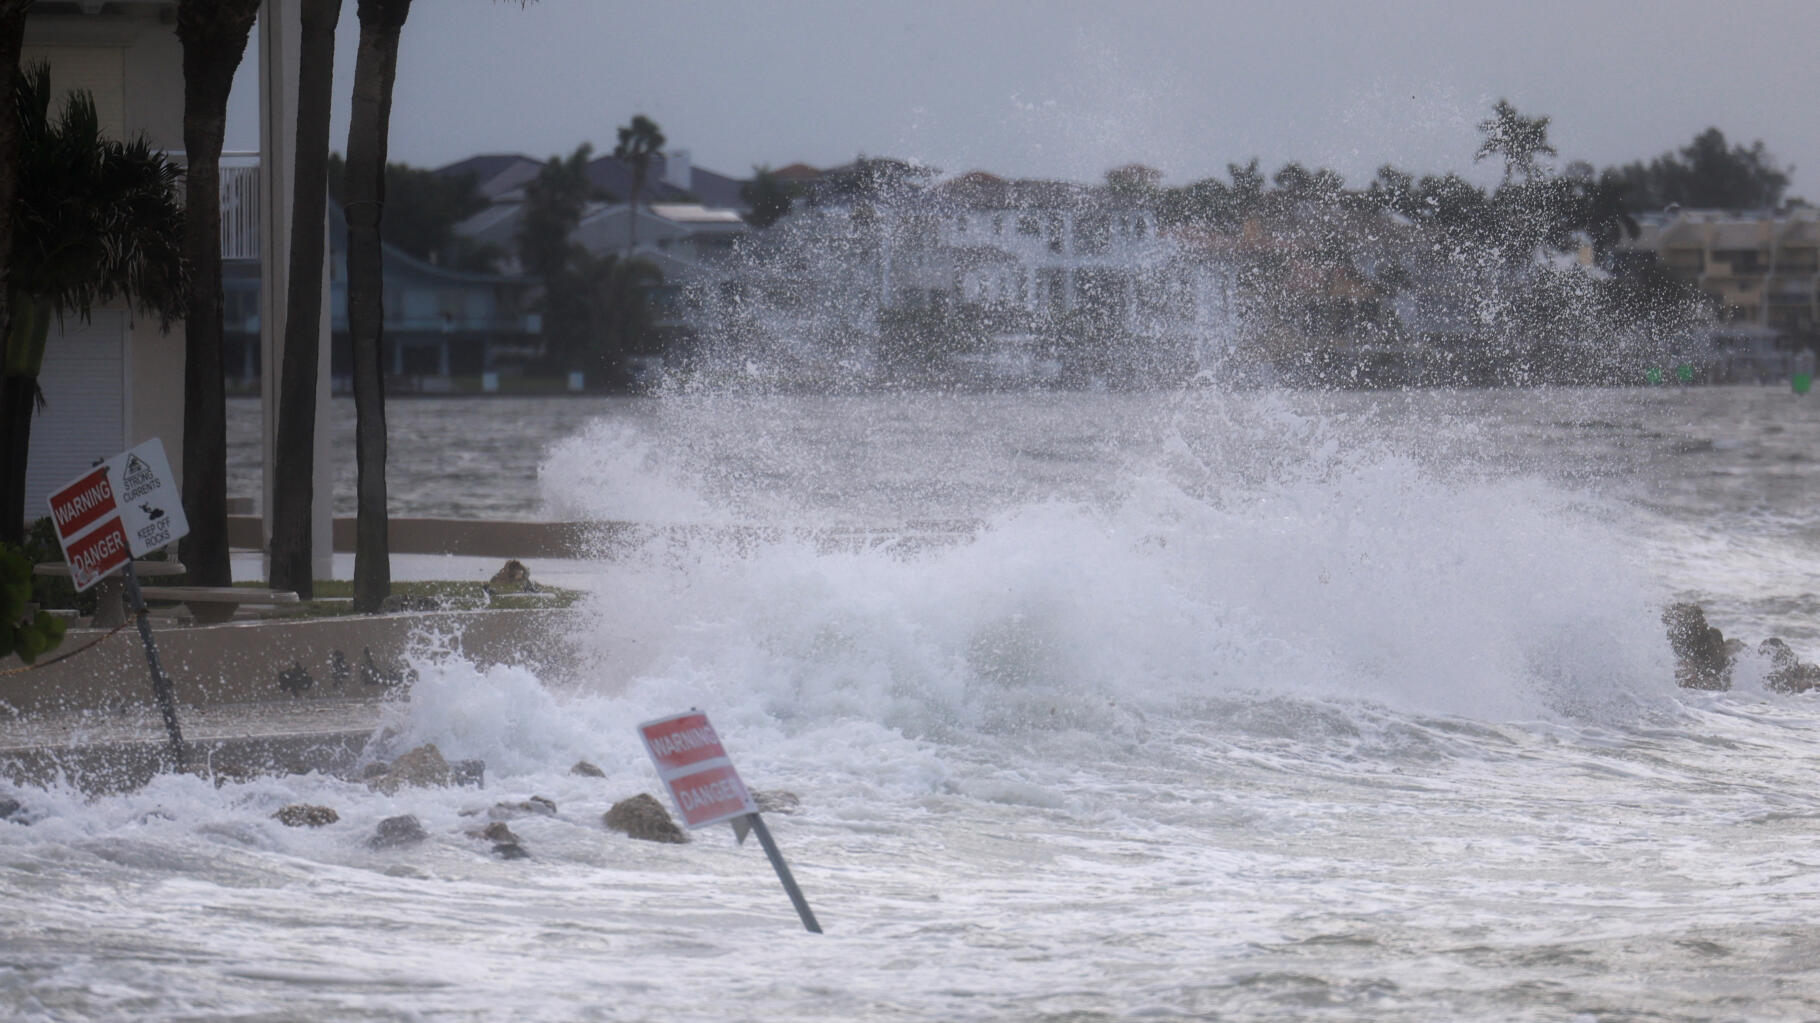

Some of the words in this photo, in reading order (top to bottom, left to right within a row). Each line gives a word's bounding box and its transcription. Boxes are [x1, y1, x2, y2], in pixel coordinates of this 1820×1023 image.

[55, 481, 112, 526] WARNING
[123, 478, 161, 503] CURRENTS
[137, 522, 156, 541] KEEP
[156, 516, 171, 531] OFF
[145, 530, 171, 549] ROCKS
[74, 530, 125, 574] DANGER
[649, 725, 720, 758] WARNING
